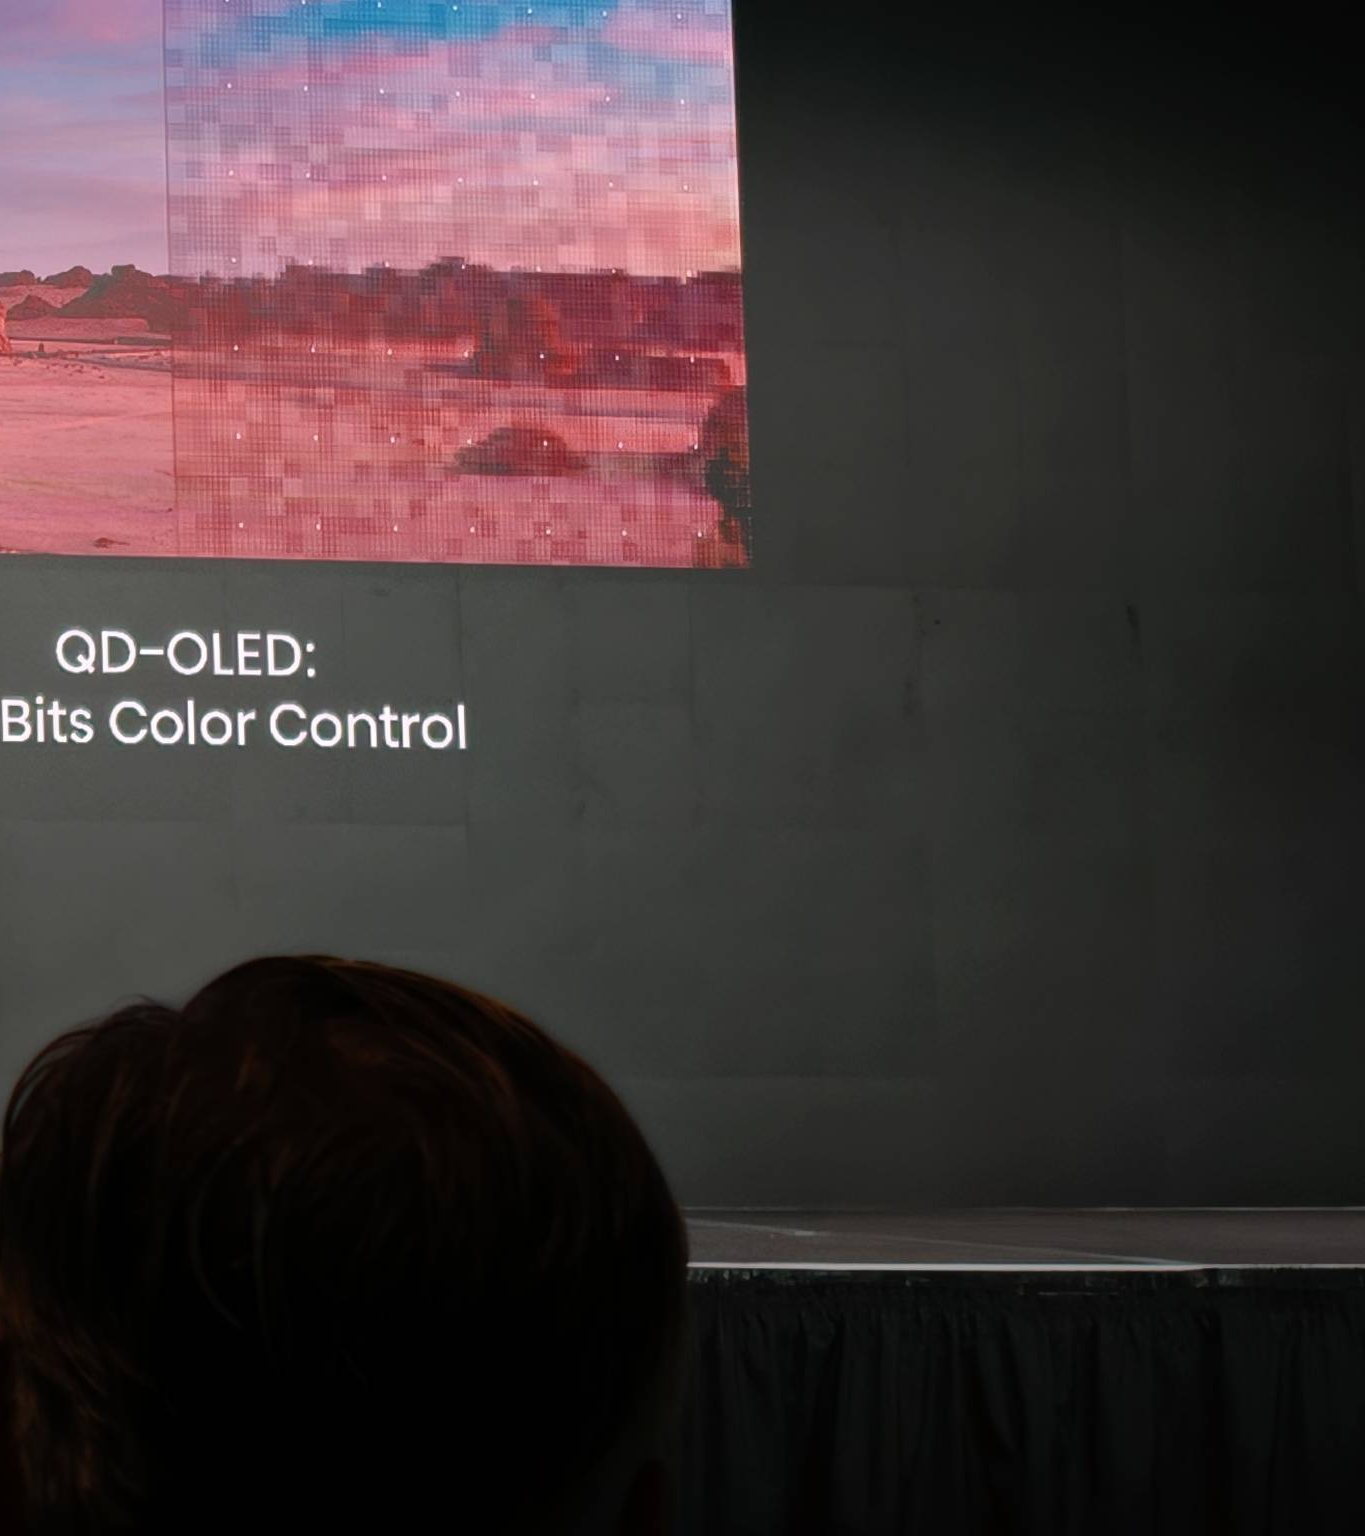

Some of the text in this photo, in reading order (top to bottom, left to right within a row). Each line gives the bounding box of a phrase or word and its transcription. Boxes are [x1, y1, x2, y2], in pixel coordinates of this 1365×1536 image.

[54, 626, 316, 678] QD-OLED:
[0, 694, 95, 745] Bits
[108, 699, 256, 747] Color
[268, 702, 468, 750] Control
